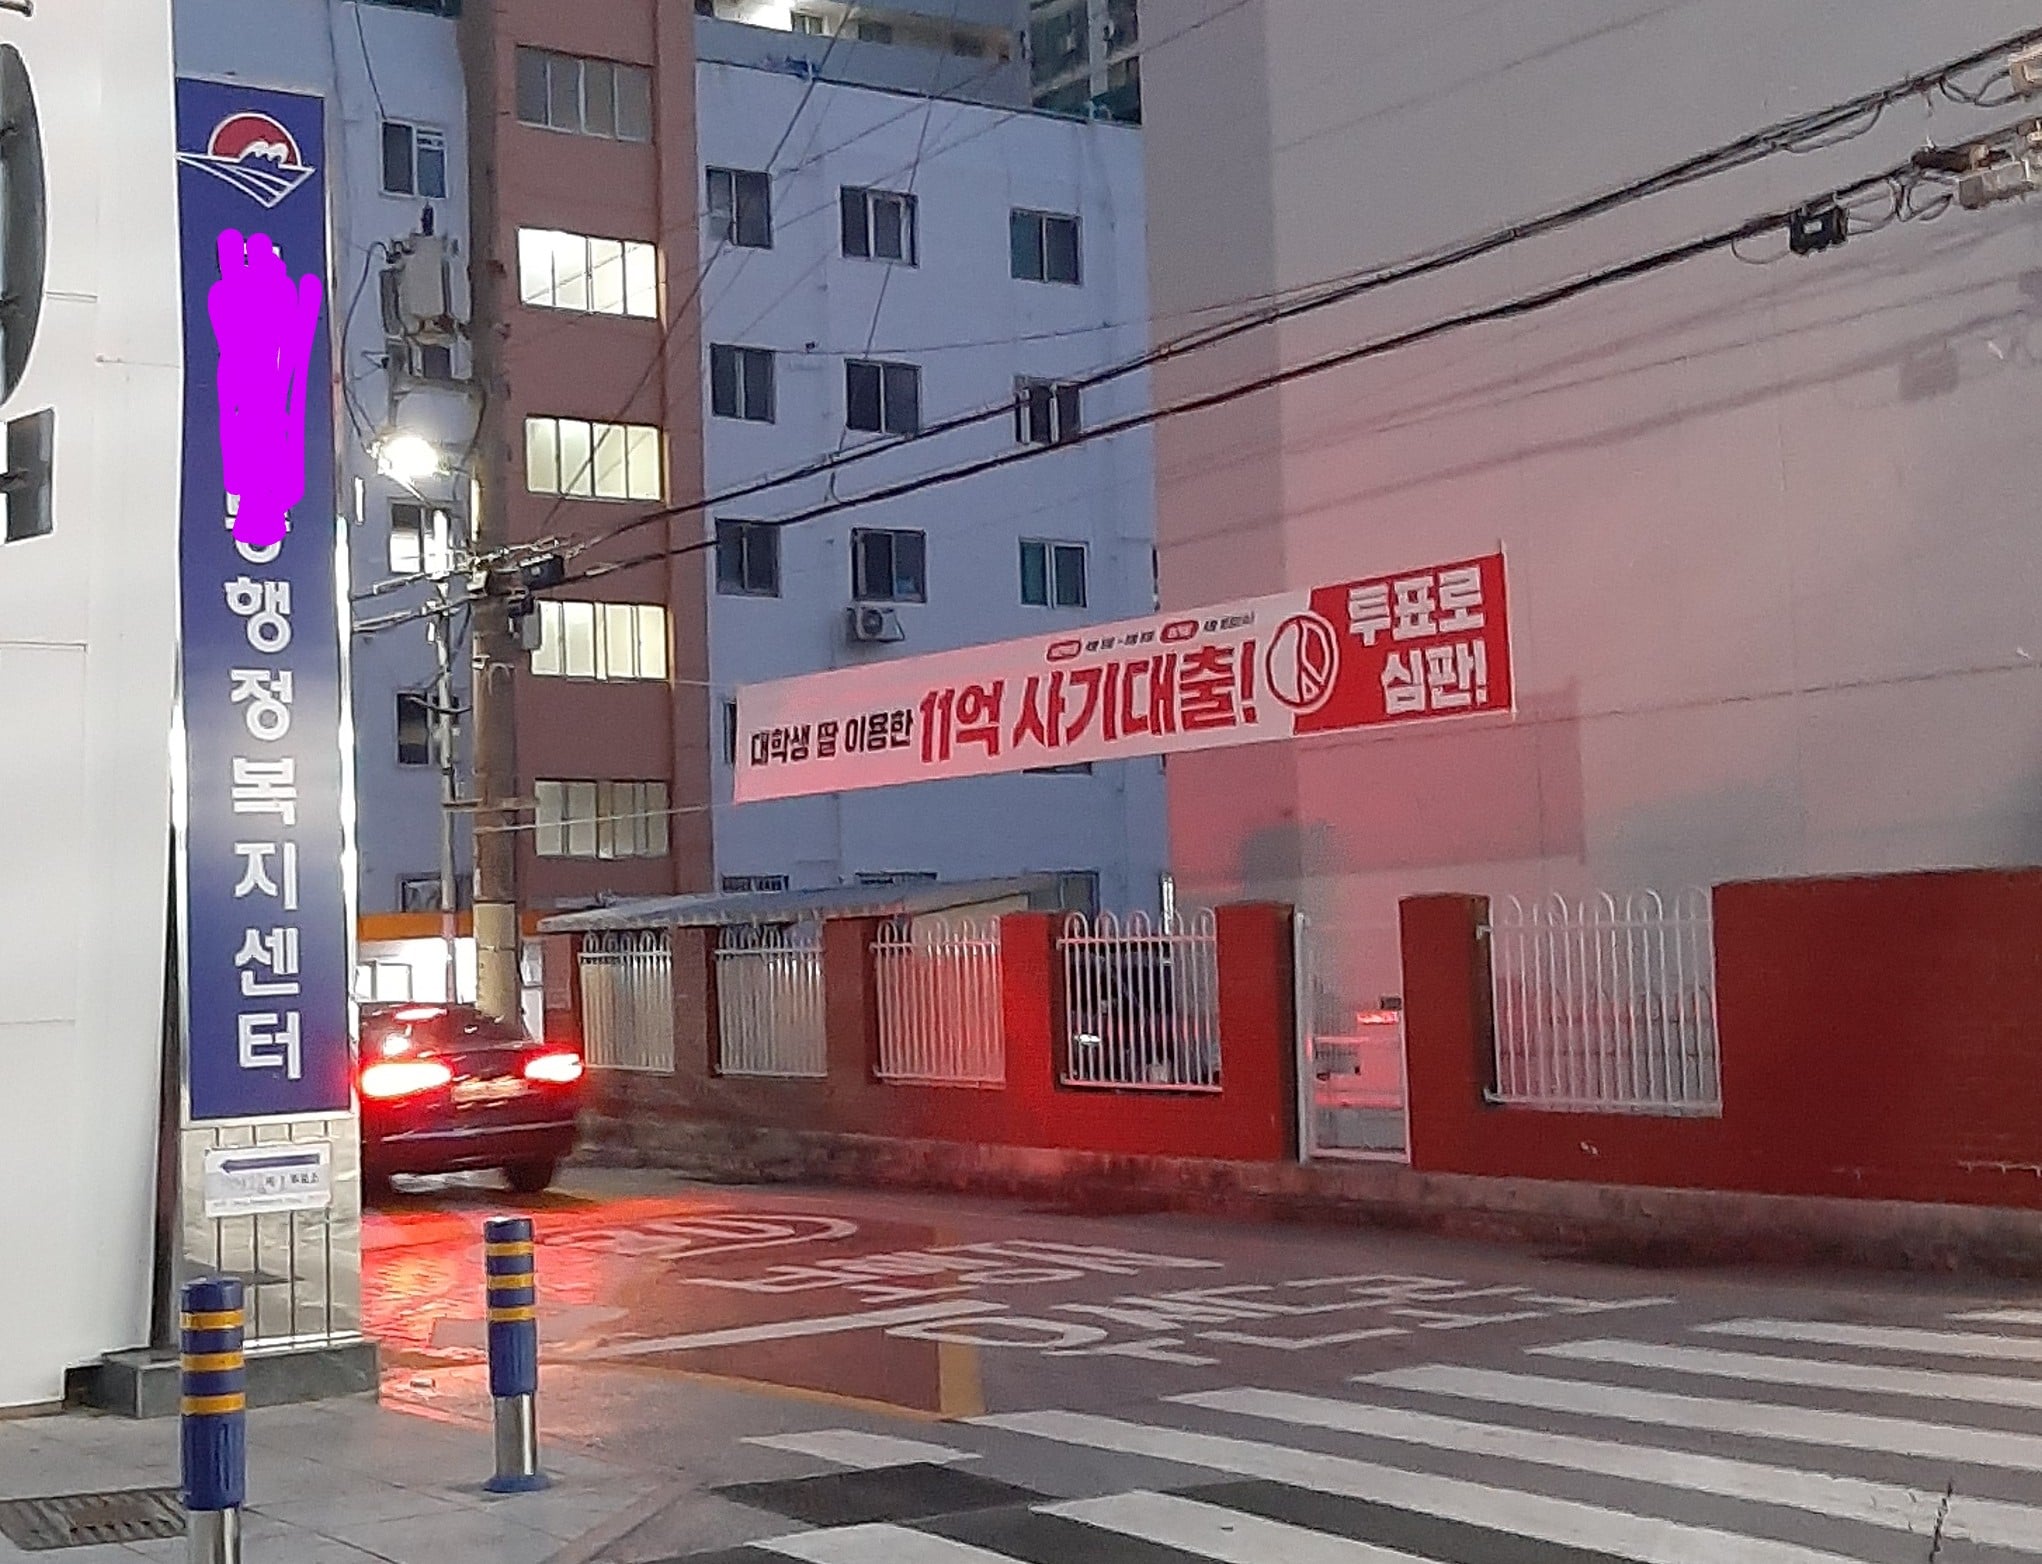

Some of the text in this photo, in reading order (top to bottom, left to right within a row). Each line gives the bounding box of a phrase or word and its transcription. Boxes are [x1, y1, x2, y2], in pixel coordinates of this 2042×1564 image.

[1346, 566, 1486, 647] 투표로
[750, 724, 812, 767] 대학생
[844, 709, 914, 753] 이용한
[919, 680, 1006, 763] 11억
[1012, 639, 1258, 748] 사기대출!
[1381, 640, 1488, 716] 심판!
[223, 576, 302, 1081] 행정복지센터
[884, 1274, 1677, 1366] 우선도로
